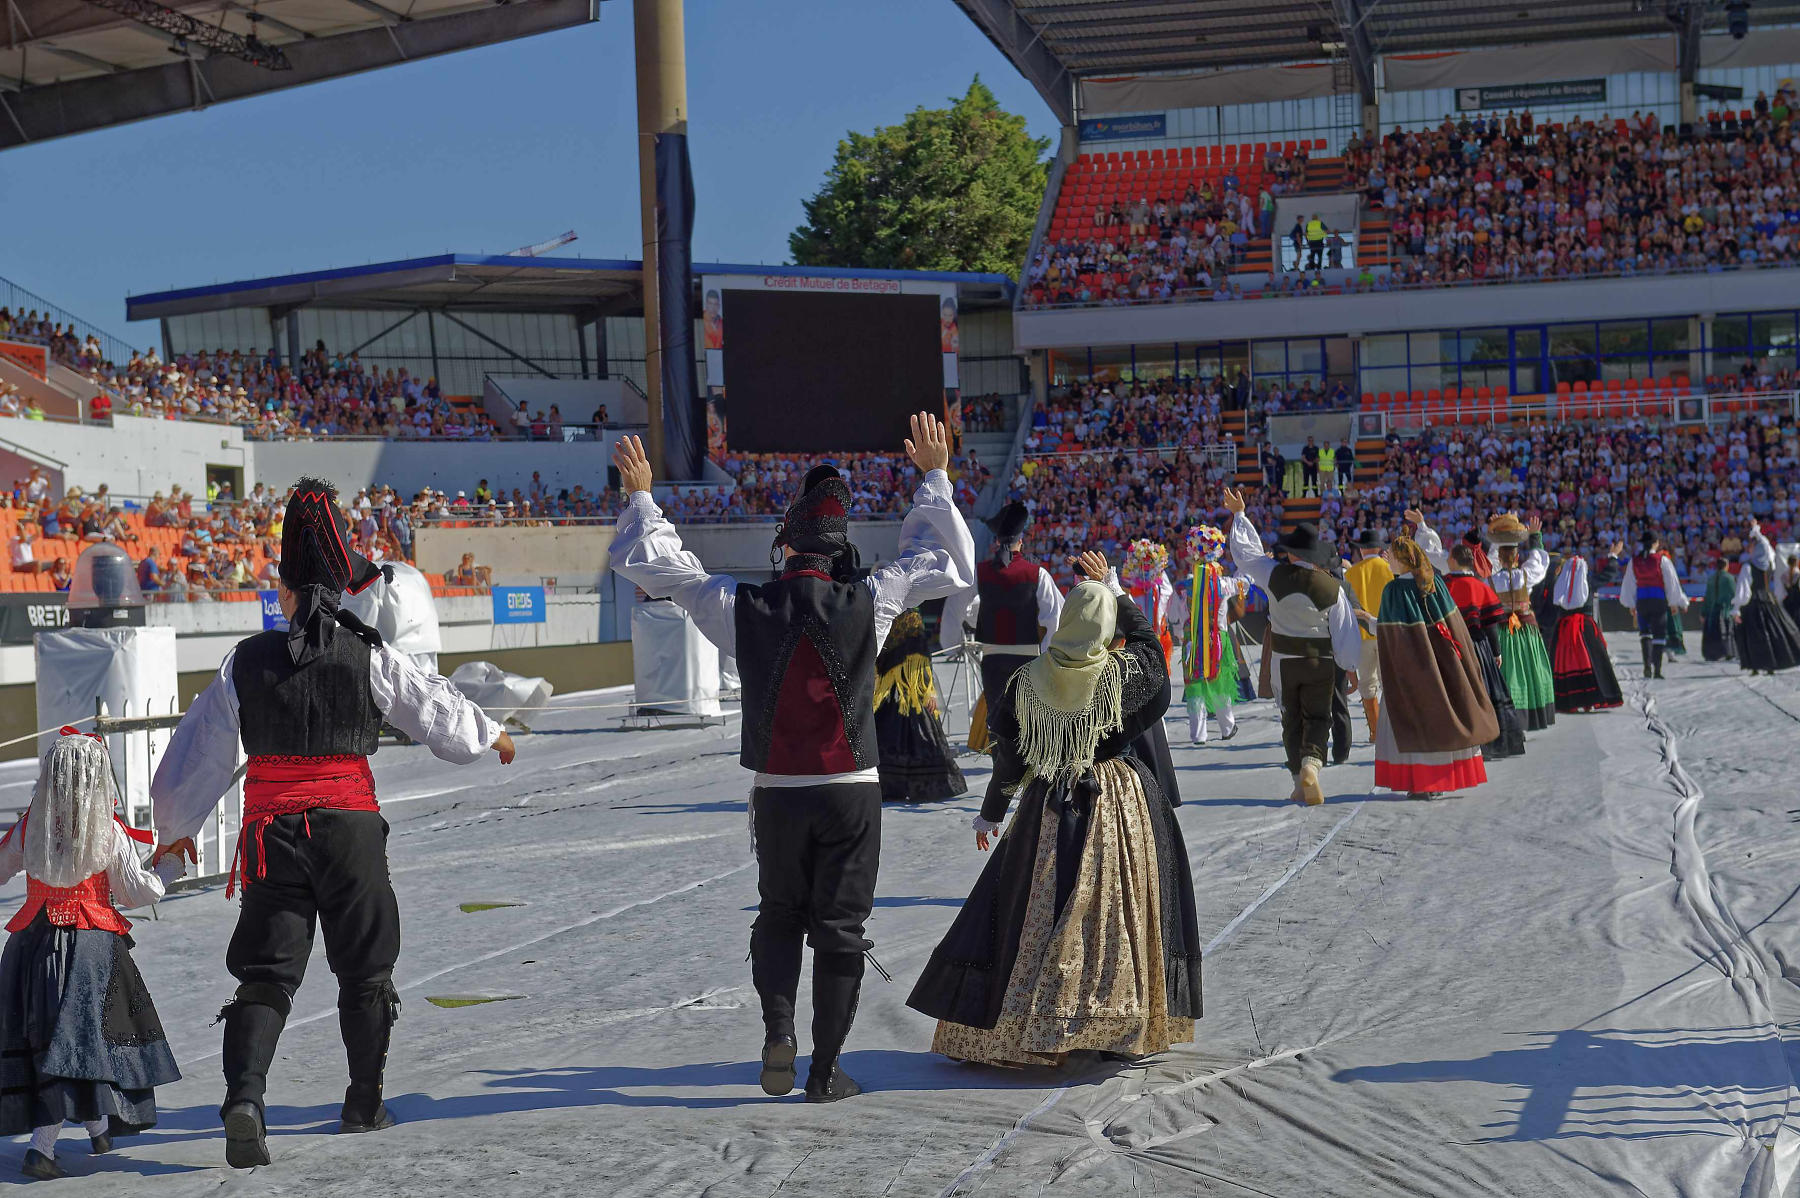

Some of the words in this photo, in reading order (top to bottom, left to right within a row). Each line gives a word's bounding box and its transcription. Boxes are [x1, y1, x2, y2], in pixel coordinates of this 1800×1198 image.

[1483, 89, 1514, 100] Conseil
[1515, 86, 1549, 99] régional
[1550, 86, 1561, 96] de
[1563, 84, 1602, 95] Bretagne
[764, 275, 797, 288] Crédit
[800, 277, 834, 289] Mutuel
[837, 279, 849, 290] de
[851, 279, 898, 293] Bretagne
